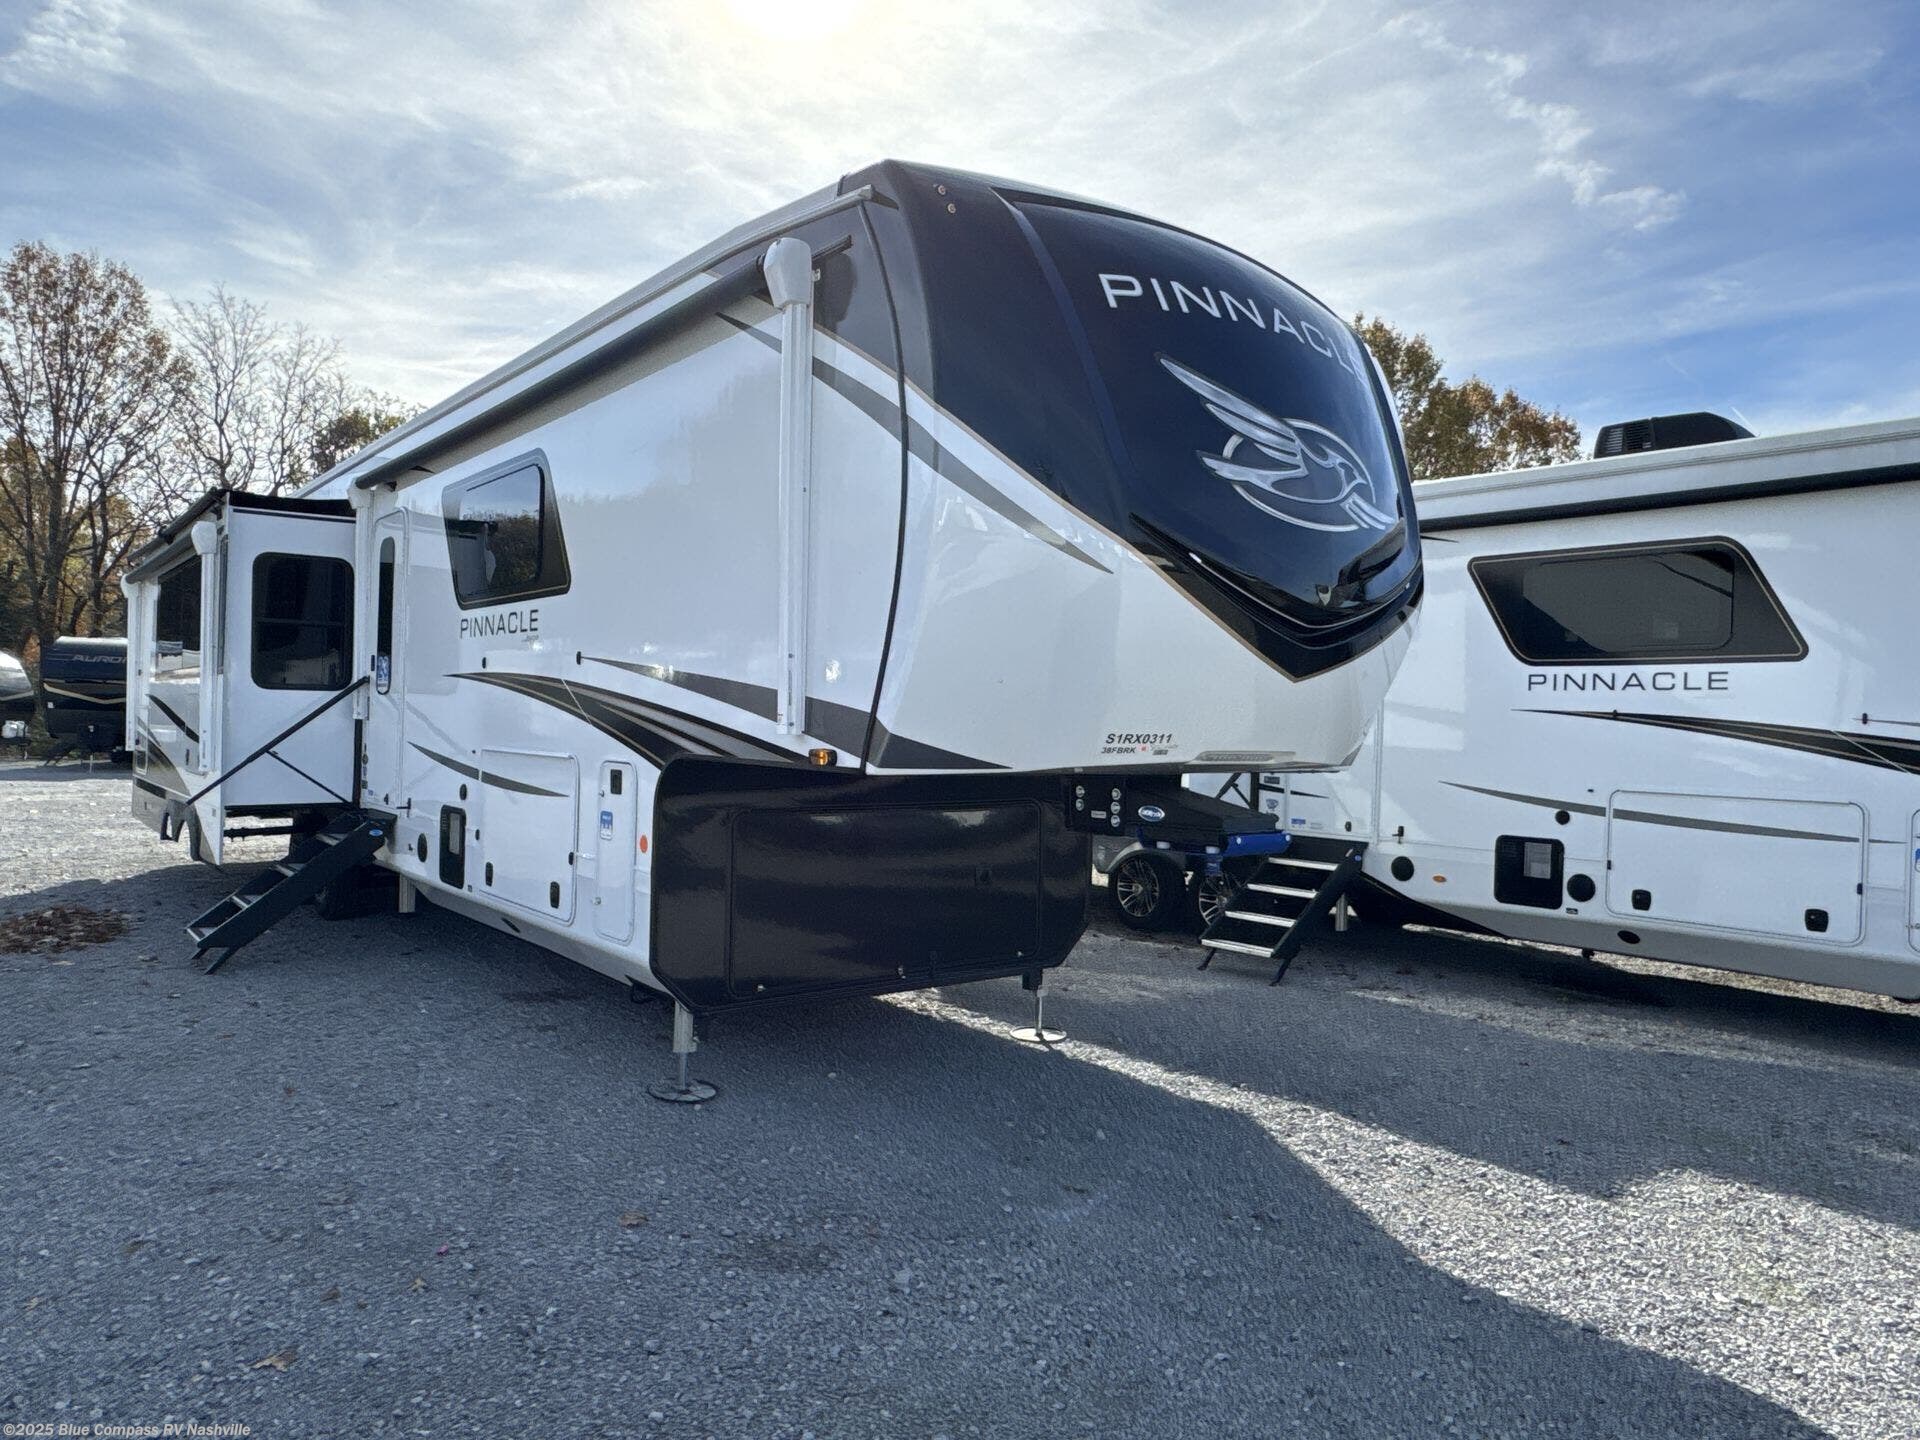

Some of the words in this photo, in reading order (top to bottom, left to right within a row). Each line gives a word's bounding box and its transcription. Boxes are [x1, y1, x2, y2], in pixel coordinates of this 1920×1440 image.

[460, 609, 539, 639] PINNACLE
[1527, 671, 1728, 691] PINNACLE
[1105, 733, 1172, 744] S1RX0311
[1101, 746, 1136, 754] 38FBRK
